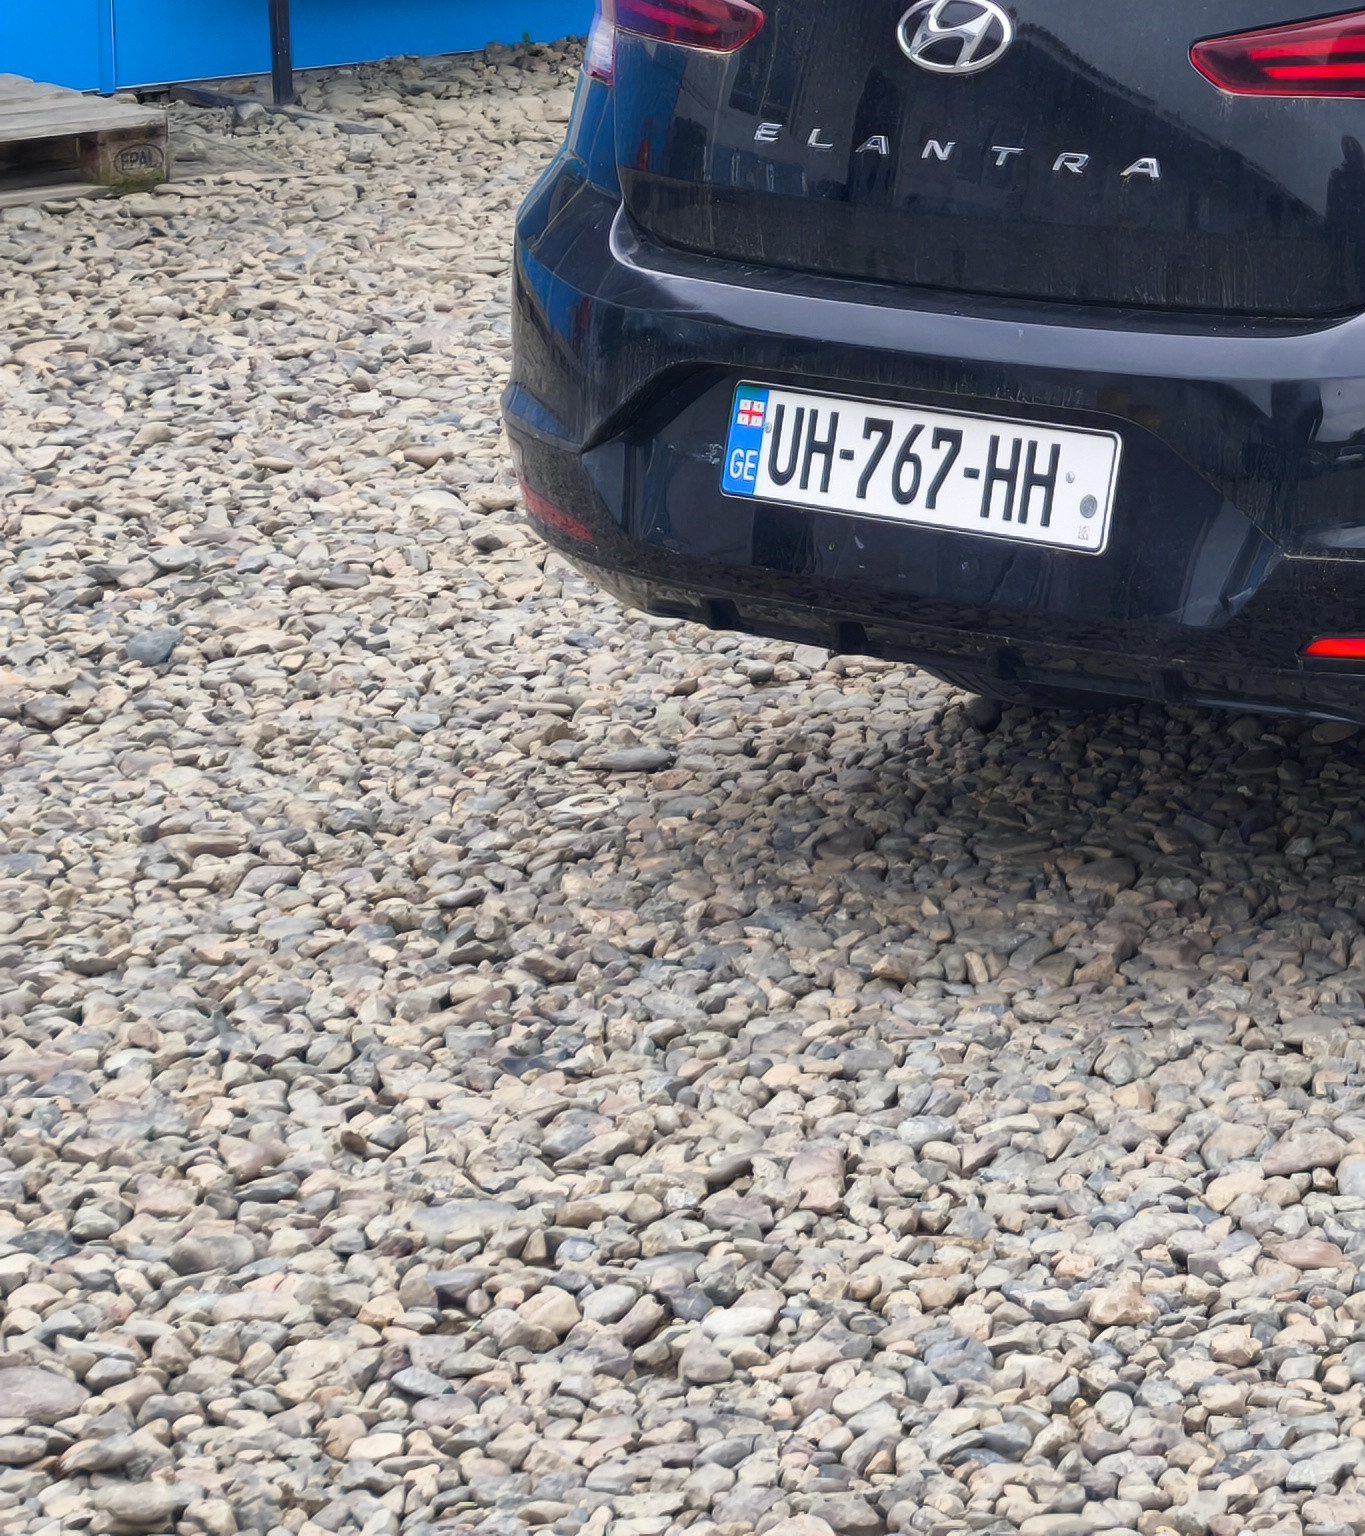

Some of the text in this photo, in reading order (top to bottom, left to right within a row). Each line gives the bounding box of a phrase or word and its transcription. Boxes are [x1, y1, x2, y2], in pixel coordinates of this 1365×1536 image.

[753, 122, 1161, 179] ELANTRA
[729, 449, 757, 481] GE
[768, 404, 1061, 527] UH-767-HH
